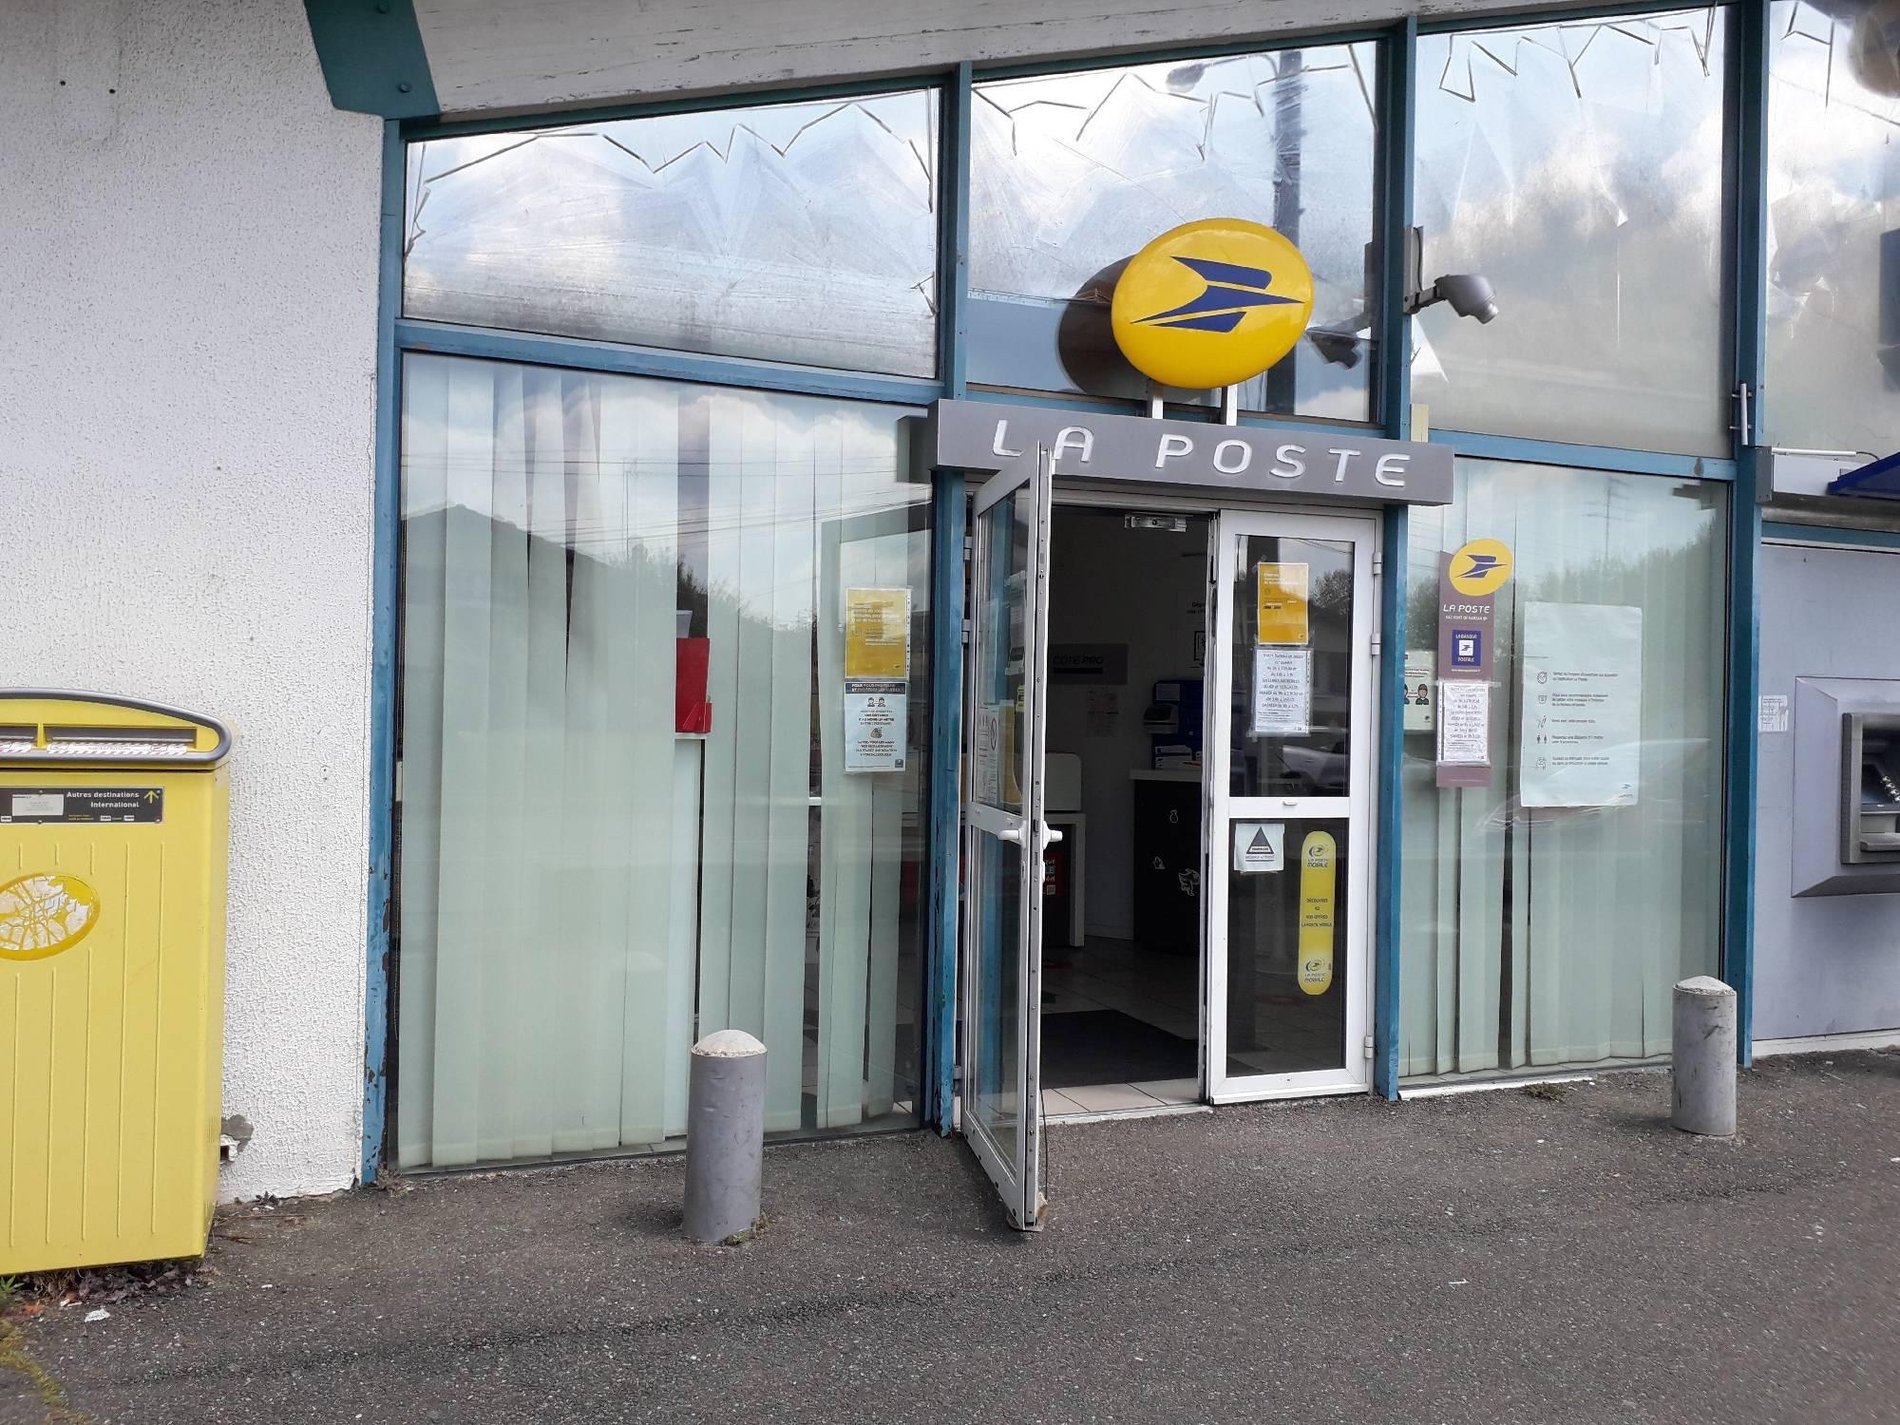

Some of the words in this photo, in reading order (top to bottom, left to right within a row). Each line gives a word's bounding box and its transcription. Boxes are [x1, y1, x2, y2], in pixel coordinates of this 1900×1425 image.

[992, 419, 1095, 463] LA
[1155, 433, 1411, 488] POSTE
[1443, 604, 1456, 612] LA
[1458, 604, 1490, 614] POSTE
